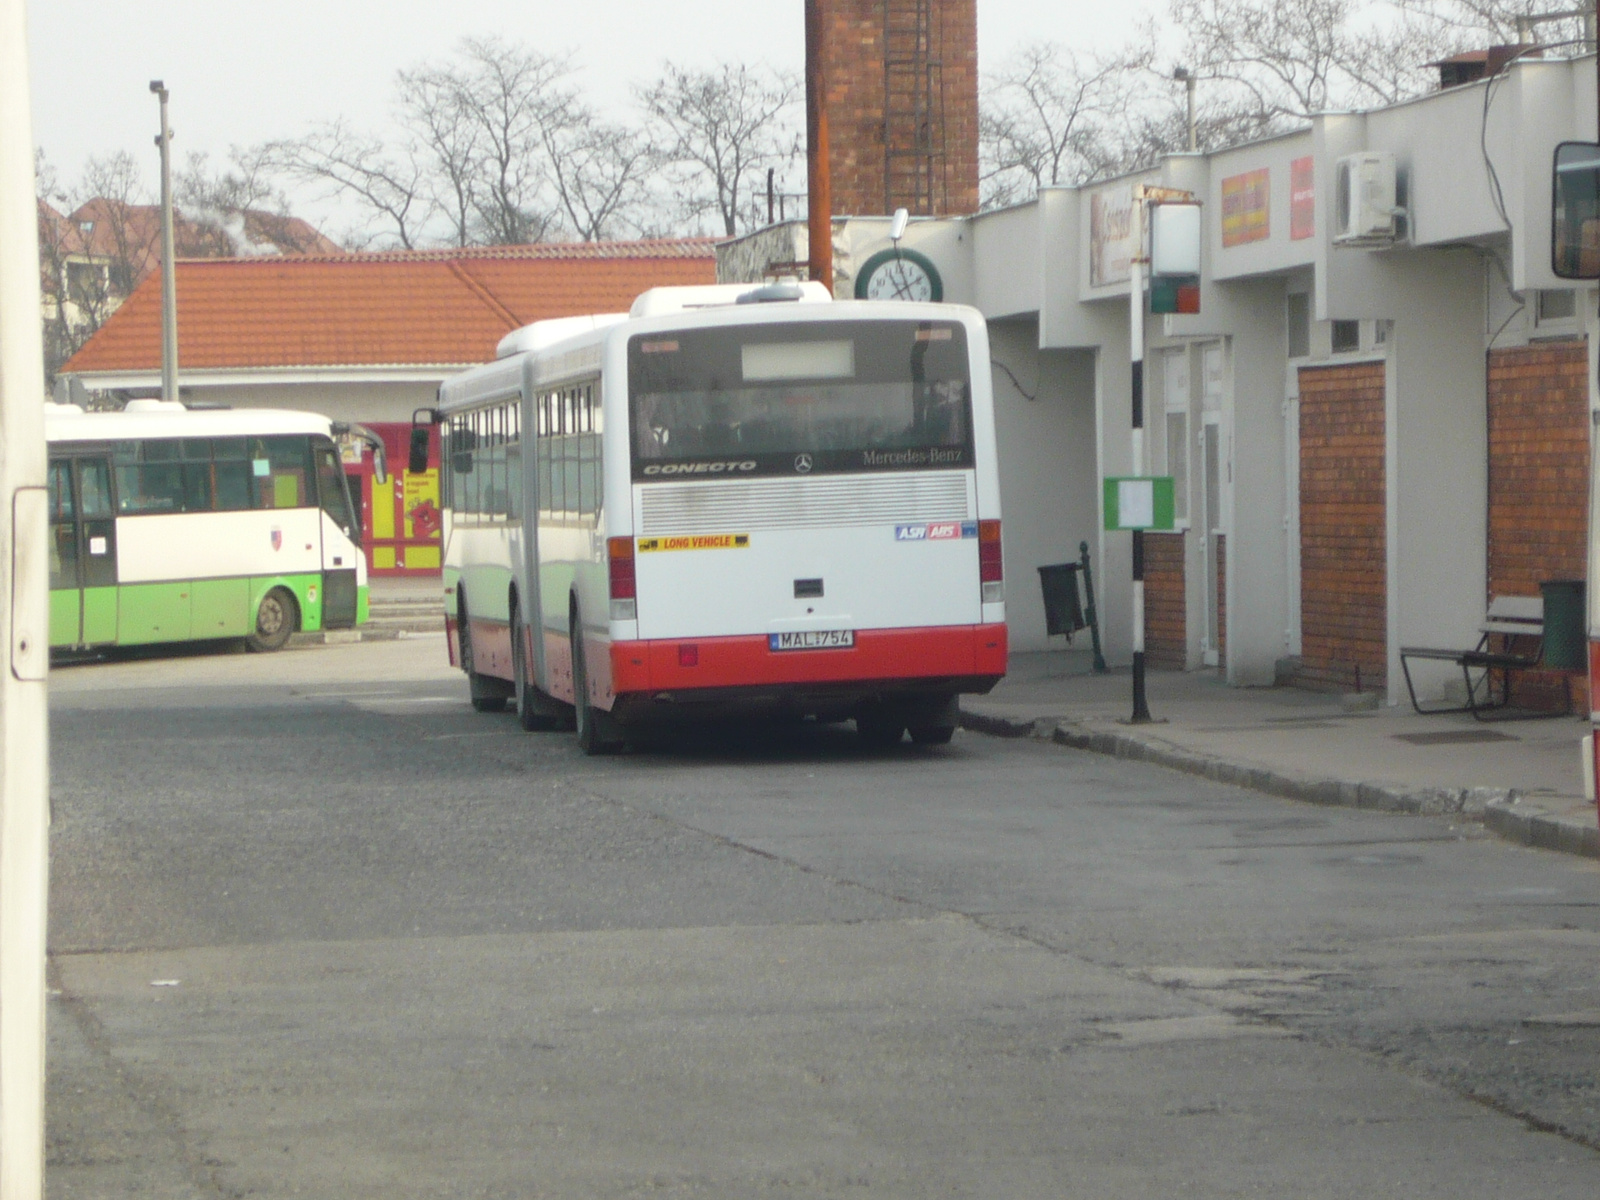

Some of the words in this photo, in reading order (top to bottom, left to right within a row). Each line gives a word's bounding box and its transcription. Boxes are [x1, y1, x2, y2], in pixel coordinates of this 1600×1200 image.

[863, 448, 962, 465] Mercedes-Benz
[643, 461, 757, 475] CONECTO
[664, 537, 690, 549] LONG
[692, 536, 731, 548] VEHICLE
